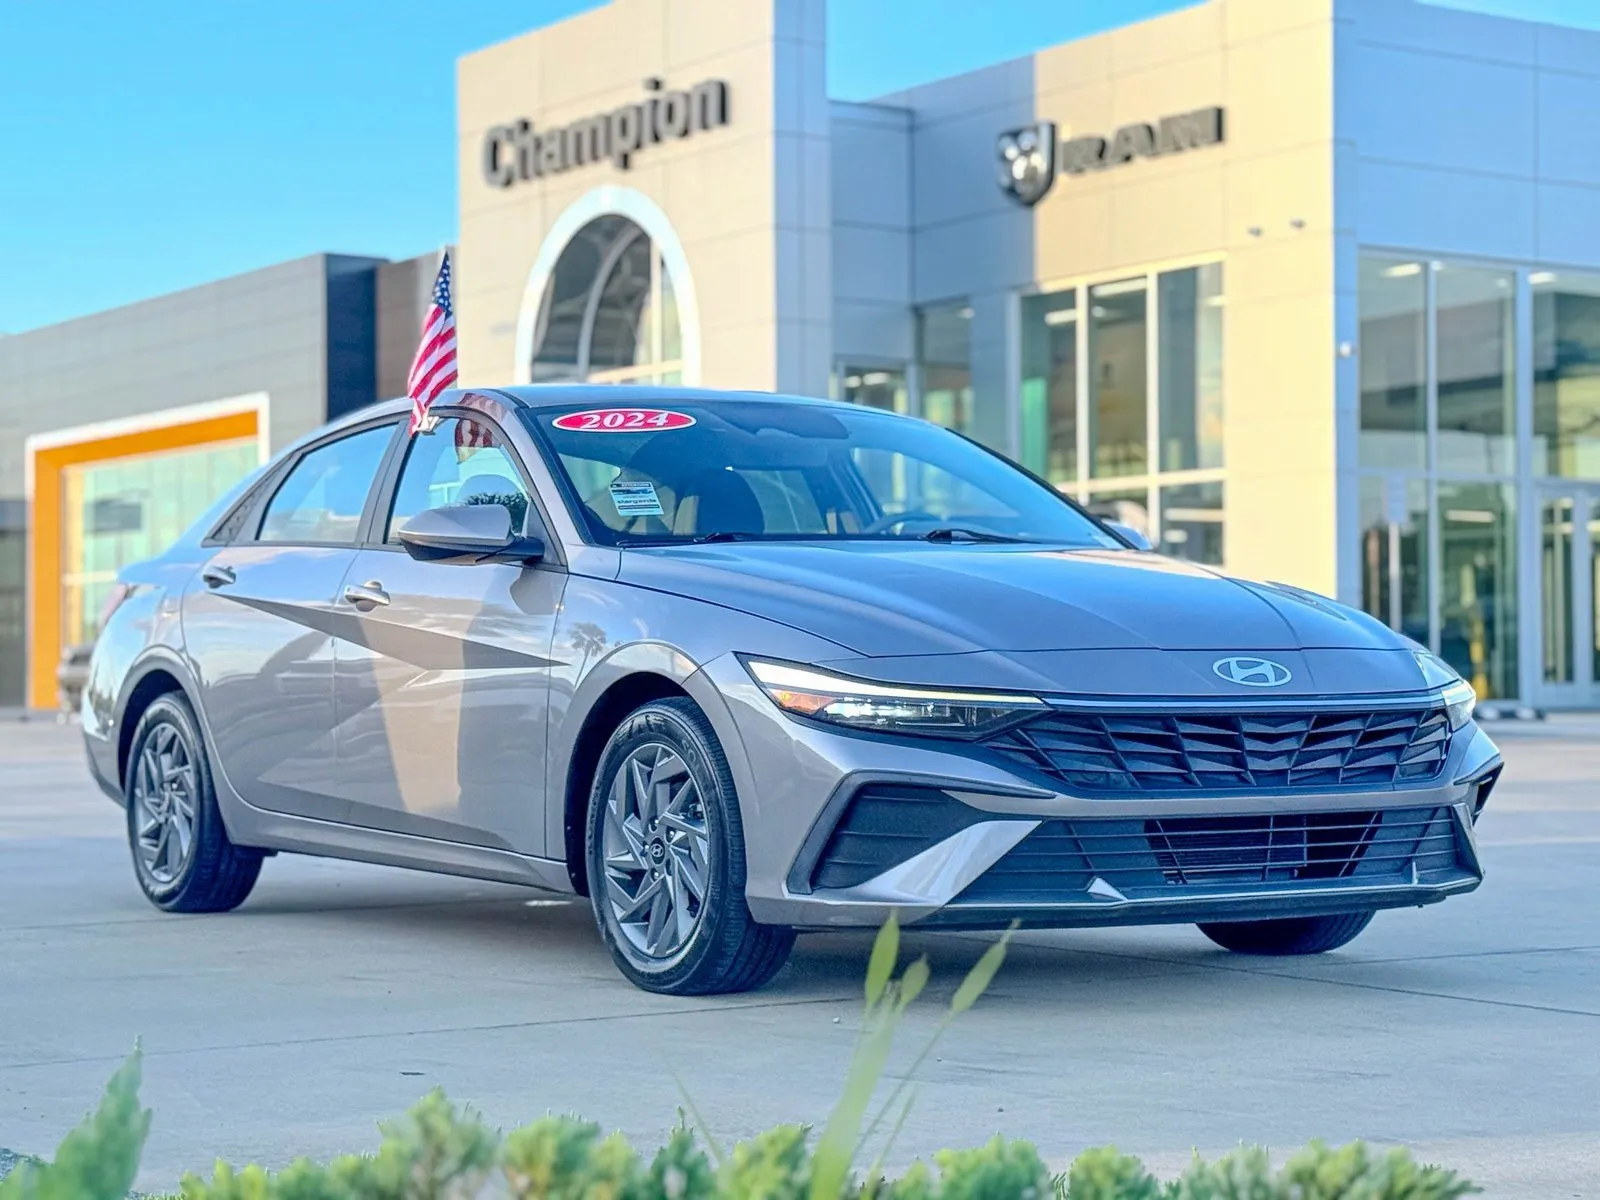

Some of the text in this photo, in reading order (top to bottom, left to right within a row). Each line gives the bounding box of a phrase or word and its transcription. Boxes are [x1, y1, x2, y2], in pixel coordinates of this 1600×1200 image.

[483, 78, 730, 187] Champion
[1062, 106, 1224, 174] RAM
[579, 411, 669, 429] 2024
